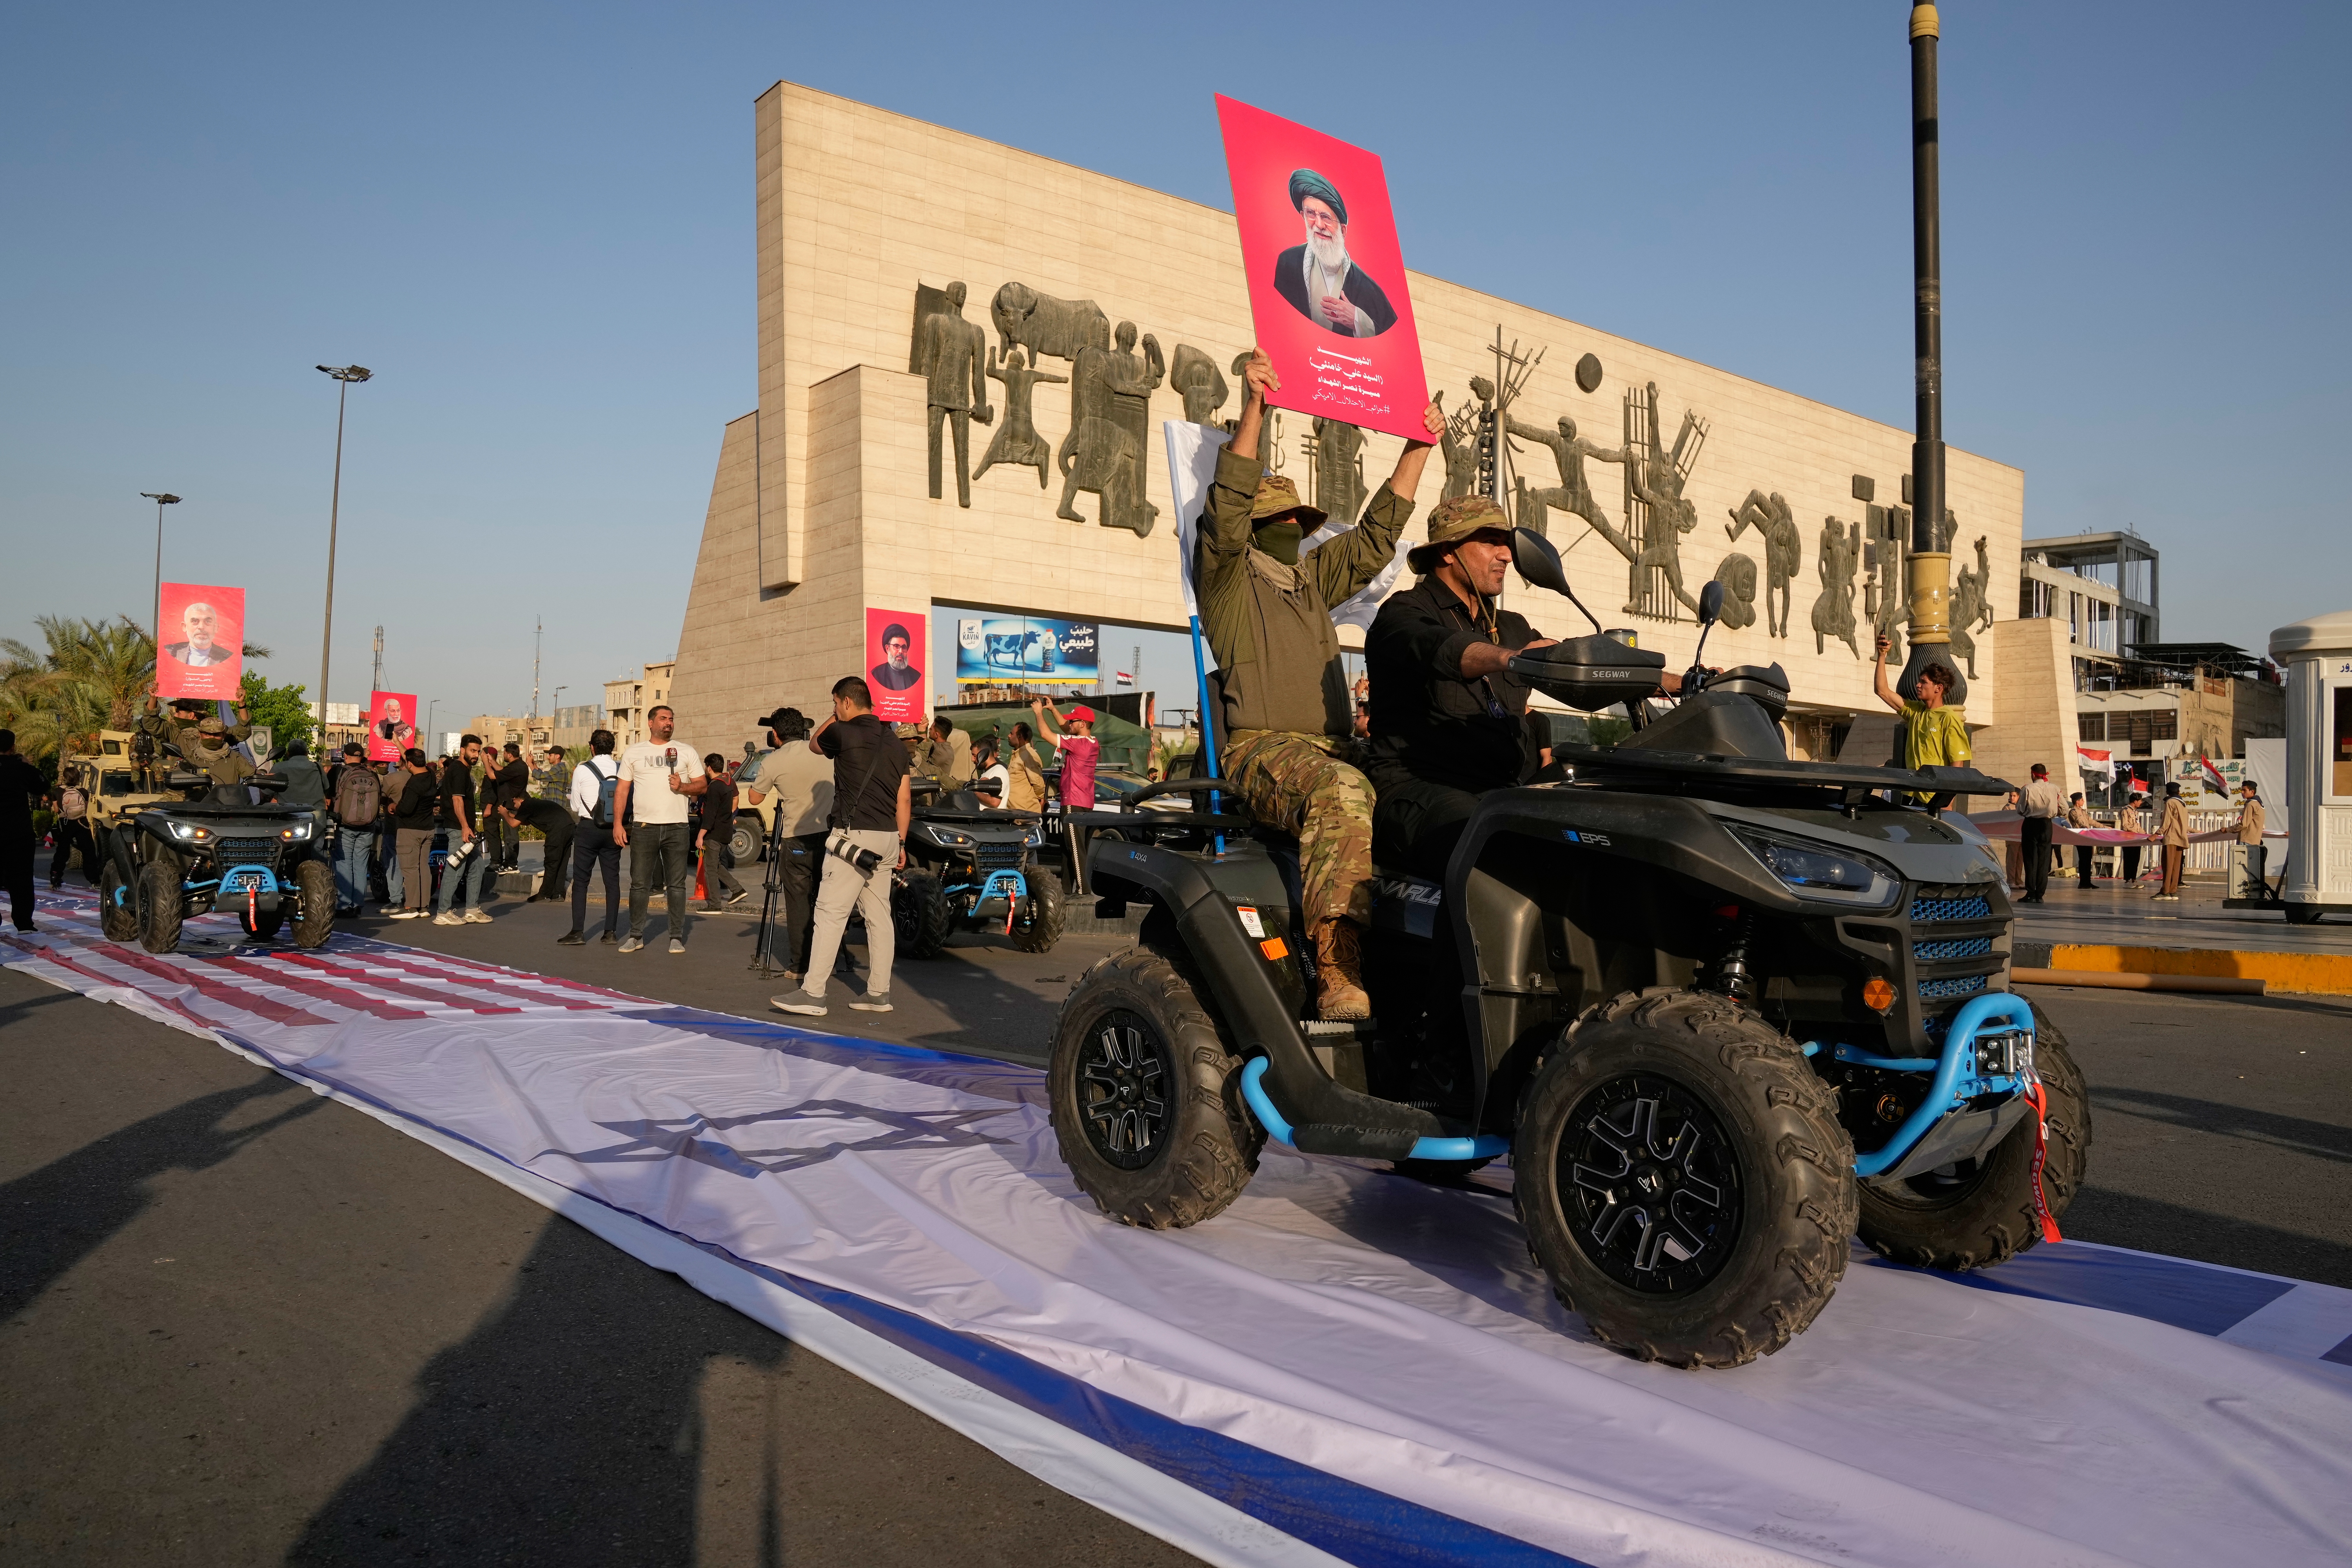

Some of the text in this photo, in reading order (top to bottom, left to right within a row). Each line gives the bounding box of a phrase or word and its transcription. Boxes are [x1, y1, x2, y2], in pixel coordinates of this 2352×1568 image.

[1317, 346, 1372, 366] الشهيد
[1310, 357, 1383, 385] (السيد علي خامنئي)
[1318, 376, 1341, 387] الشهداء
[1358, 385, 1380, 398] مسيرة
[1070, 626, 1093, 636] حليب
[1059, 636, 1094, 652] طبيعي
[1767, 690, 1786, 702] SEGWAY
[1579, 832, 1611, 846] EPS
[1135, 853, 1147, 862] 4X4
[2032, 1149, 2047, 1217] SEGWAY
